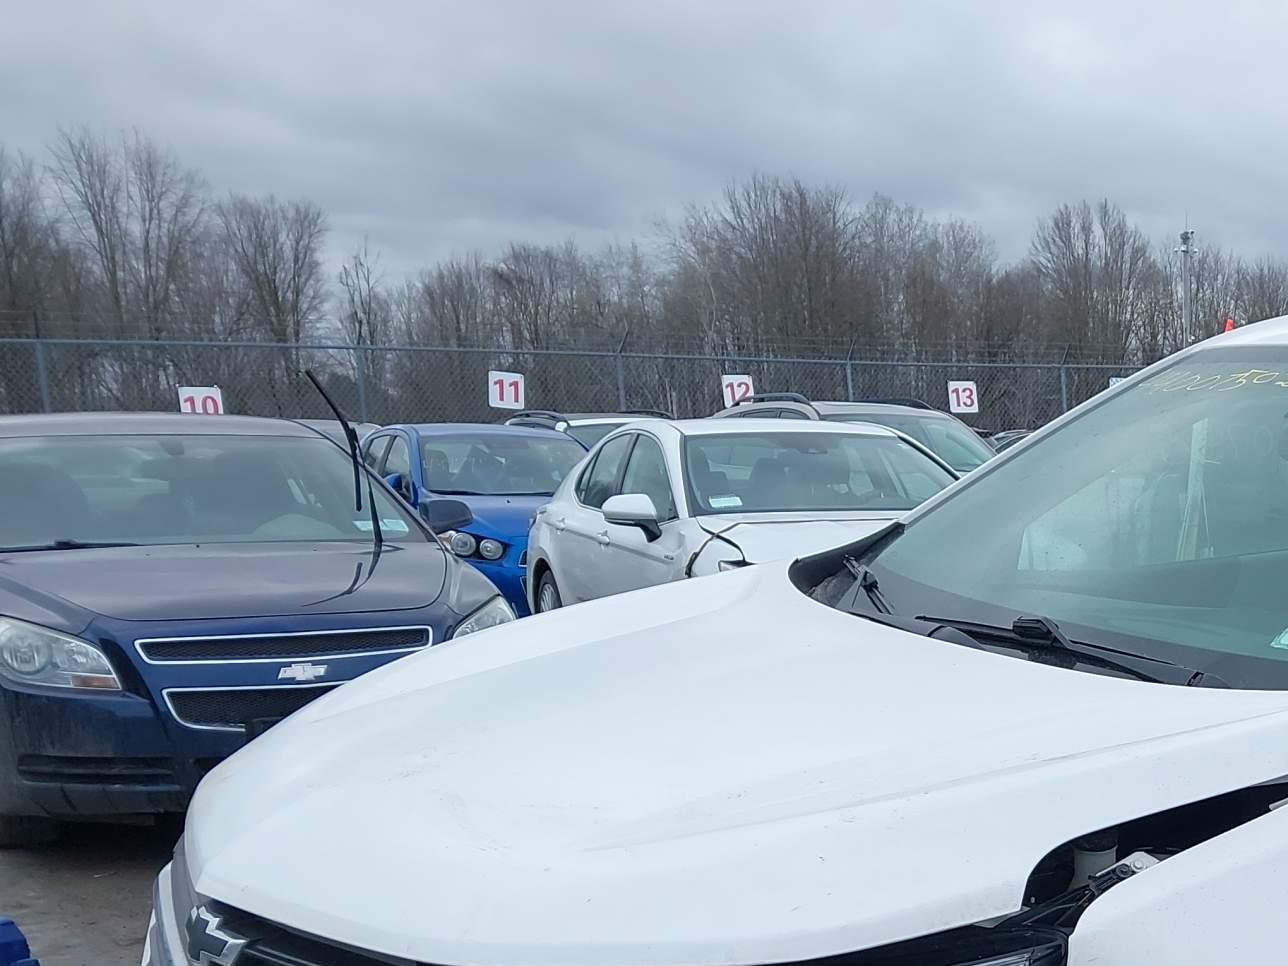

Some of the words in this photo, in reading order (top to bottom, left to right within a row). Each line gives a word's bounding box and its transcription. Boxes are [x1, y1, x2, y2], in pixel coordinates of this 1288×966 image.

[493, 378, 521, 403] 11
[724, 381, 751, 402] 12
[950, 387, 976, 408] 13
[183, 395, 220, 415] 10
